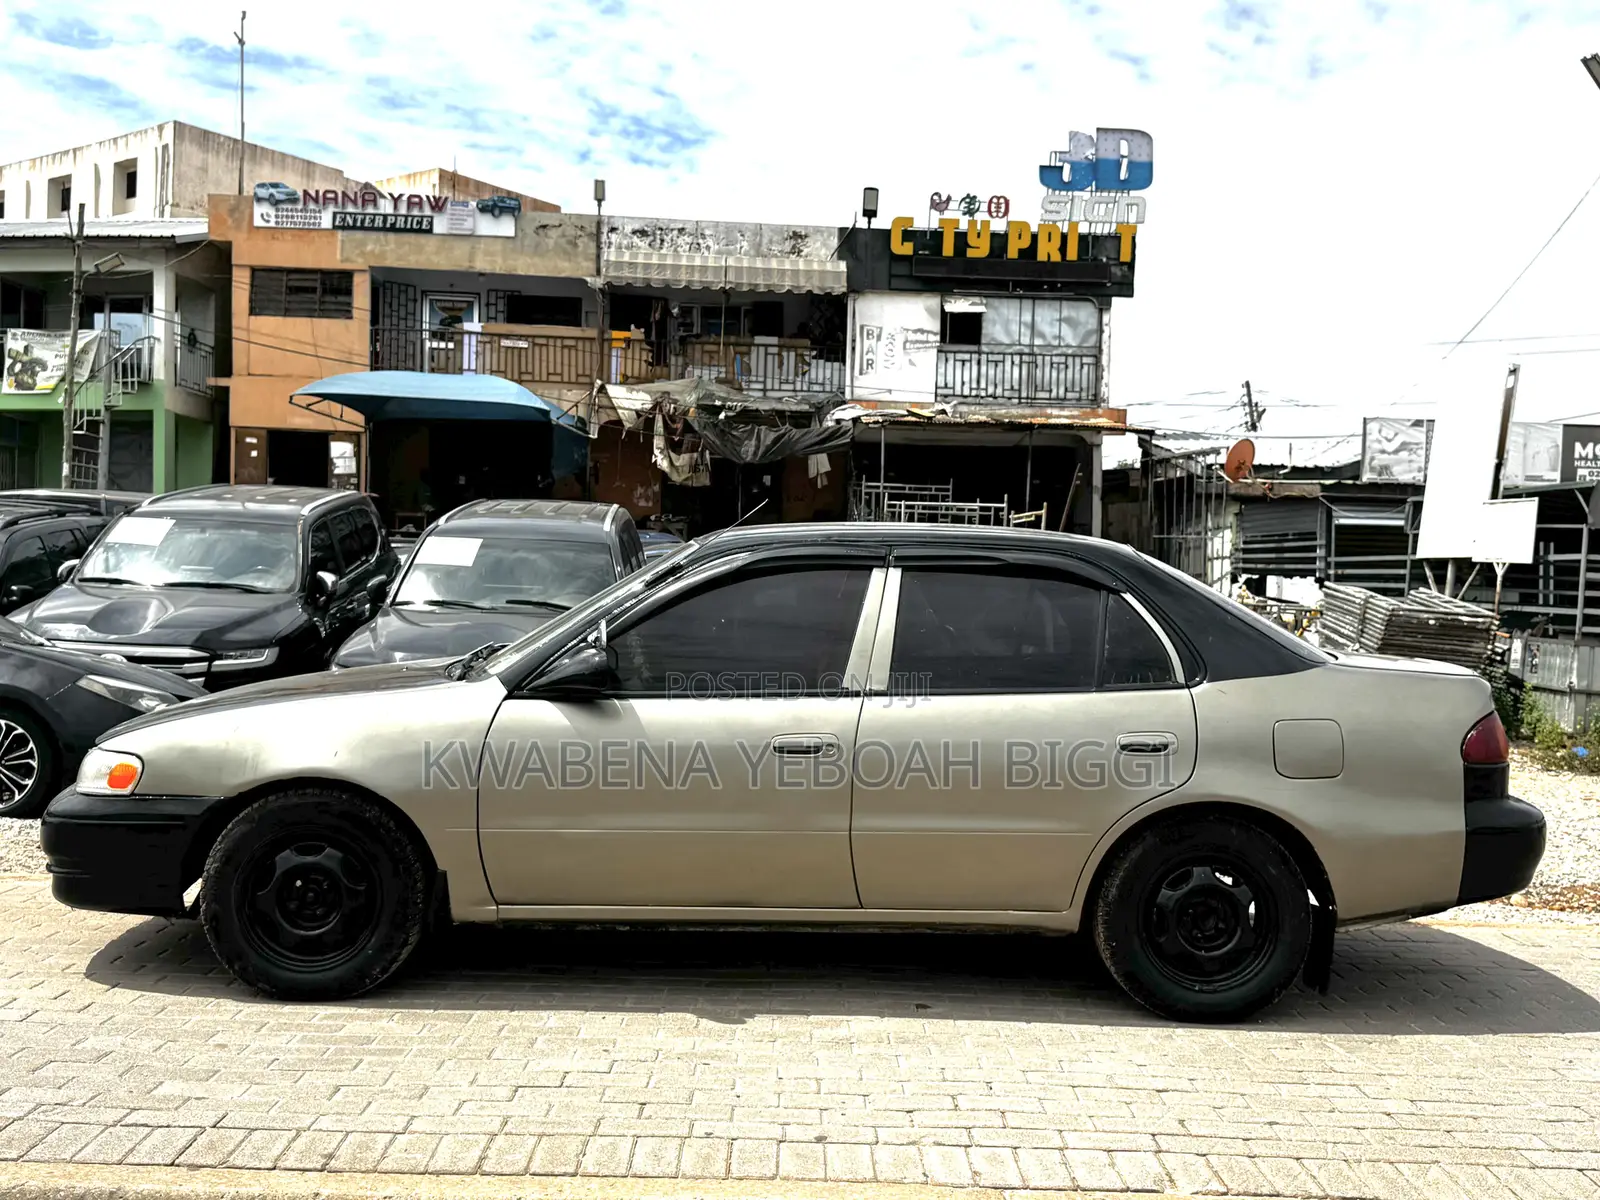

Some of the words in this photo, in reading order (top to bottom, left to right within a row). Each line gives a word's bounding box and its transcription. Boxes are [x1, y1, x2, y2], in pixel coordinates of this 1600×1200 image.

[1039, 127, 1154, 191] 3D
[302, 189, 378, 209] NANA
[388, 192, 450, 213] YAW
[890, 216, 991, 259] CTY
[1007, 221, 1138, 263] PRIT
[866, 328, 875, 371] BAR
